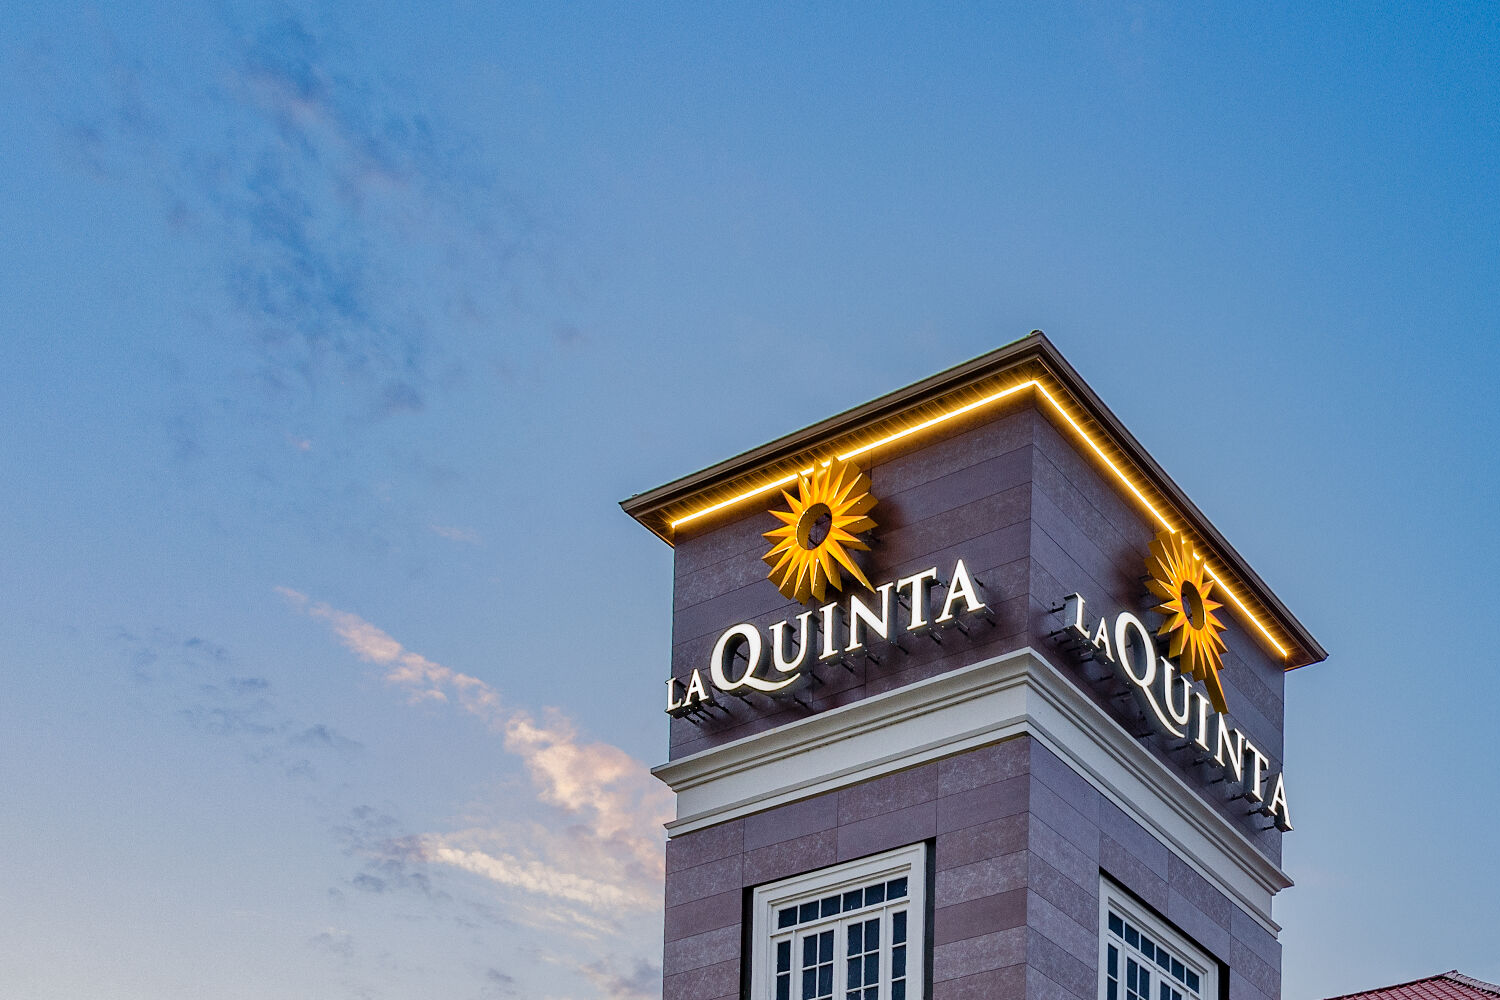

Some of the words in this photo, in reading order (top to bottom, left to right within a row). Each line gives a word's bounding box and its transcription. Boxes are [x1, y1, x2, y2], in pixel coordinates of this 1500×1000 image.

[665, 668, 709, 712] LA
[710, 558, 985, 692] QUINTA
[1072, 592, 1115, 663] LA
[1115, 611, 1293, 831] QUINTA
